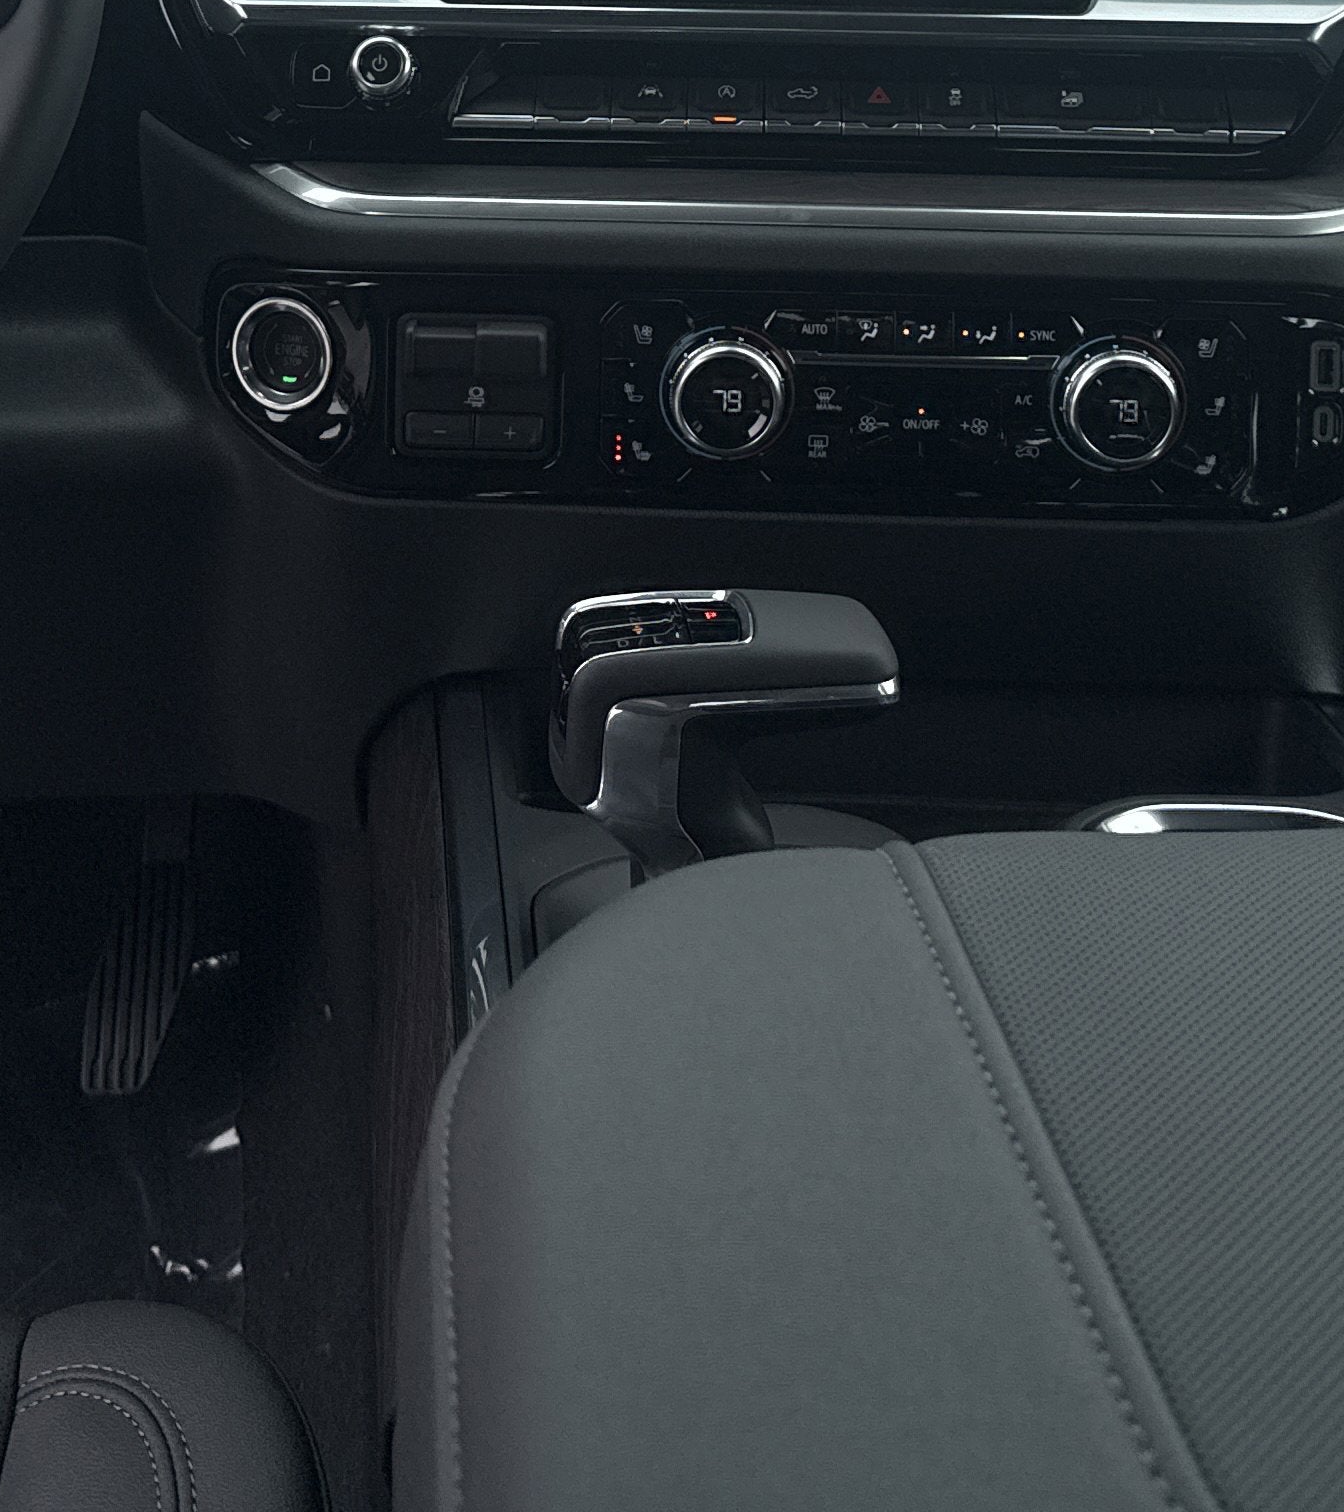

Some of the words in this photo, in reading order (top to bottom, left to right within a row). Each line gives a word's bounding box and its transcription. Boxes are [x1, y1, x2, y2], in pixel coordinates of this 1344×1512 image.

[801, 323, 828, 335] AUTO
[1029, 329, 1057, 342] SYNC
[712, 389, 743, 413] 79
[1014, 395, 1033, 406] A/C
[1110, 398, 1140, 425] 79
[902, 419, 941, 430] ON/OFF
